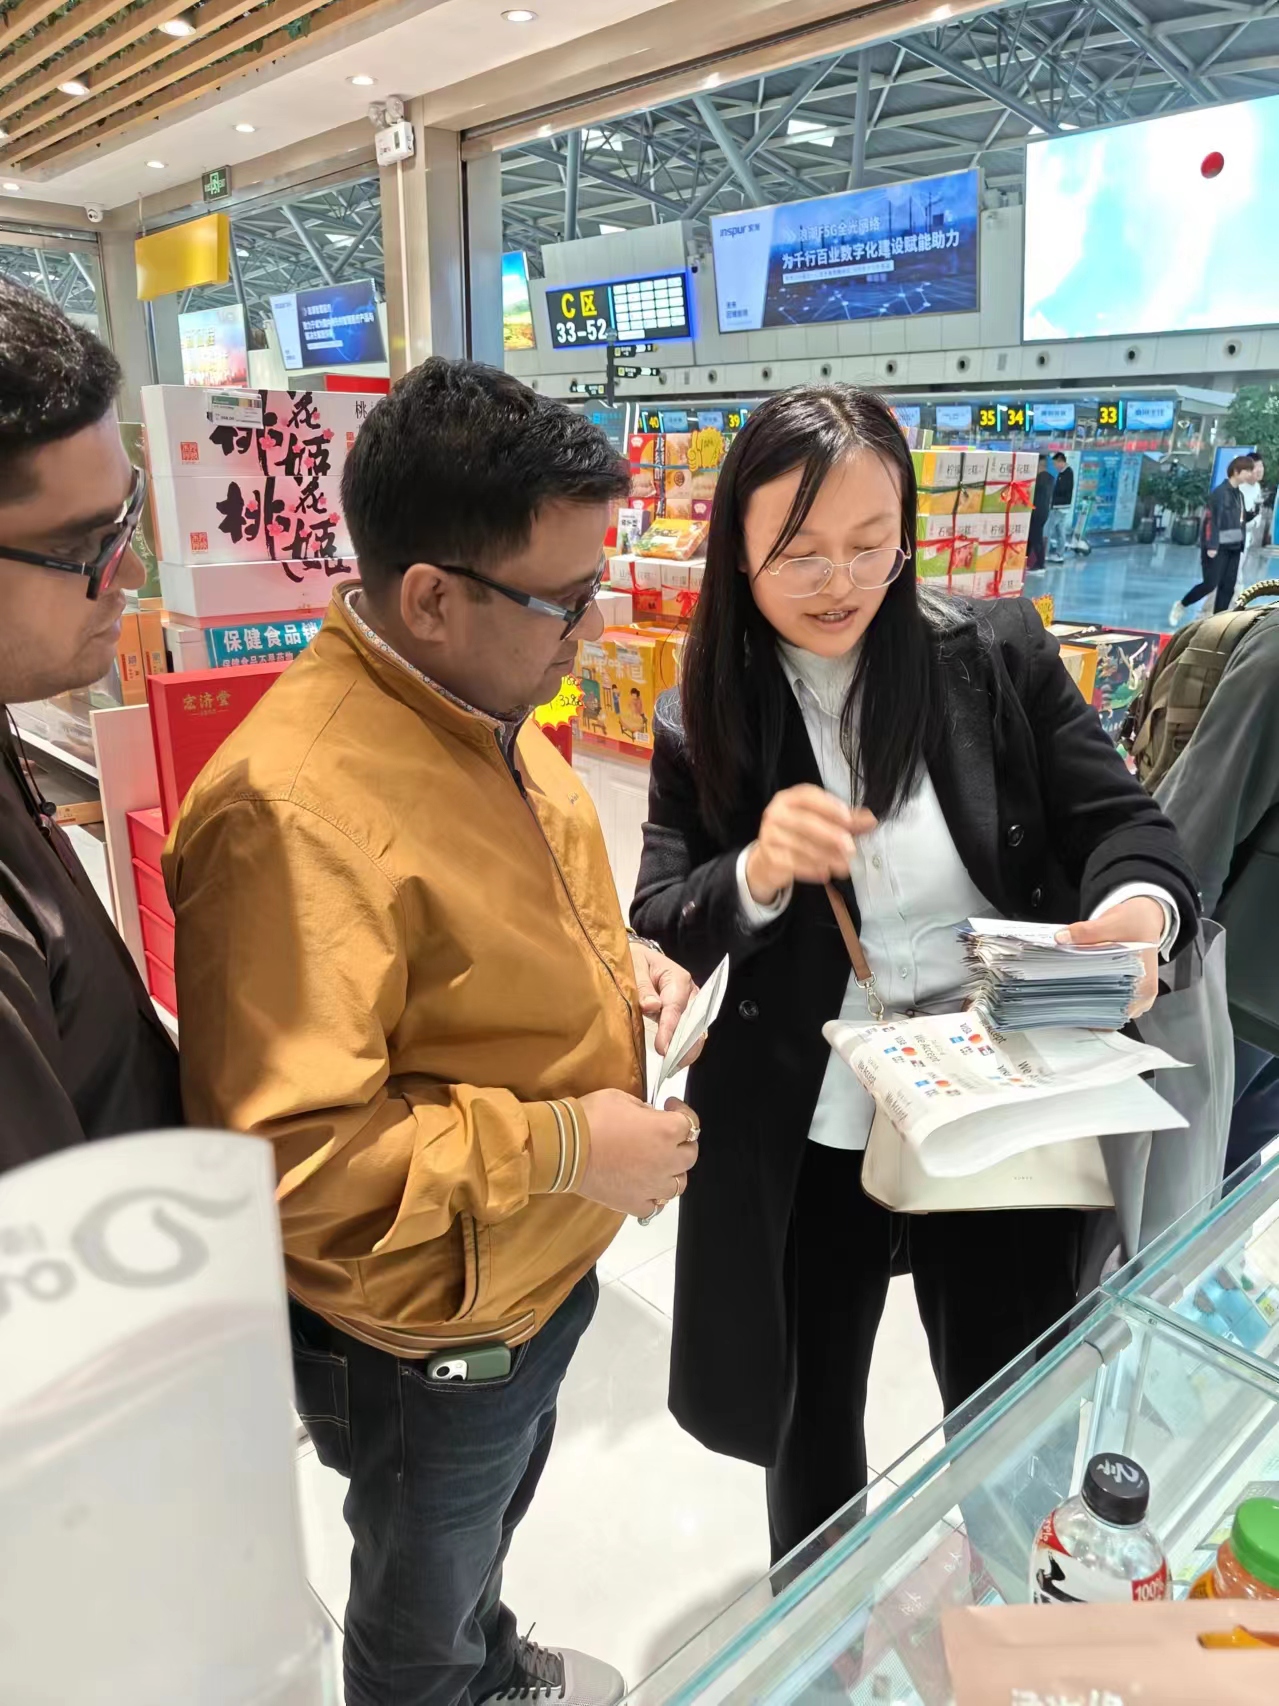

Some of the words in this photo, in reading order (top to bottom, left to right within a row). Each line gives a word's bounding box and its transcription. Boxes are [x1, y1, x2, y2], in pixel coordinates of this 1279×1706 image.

[556, 319, 608, 344] 33-52
[728, 415, 740, 428] 39
[980, 410, 995, 426] 35
[1007, 410, 1024, 426] 34
[1100, 407, 1117, 424] 33
[183, 690, 231, 711] 宏济堂
[1134, 1577, 1165, 1600] 100%
